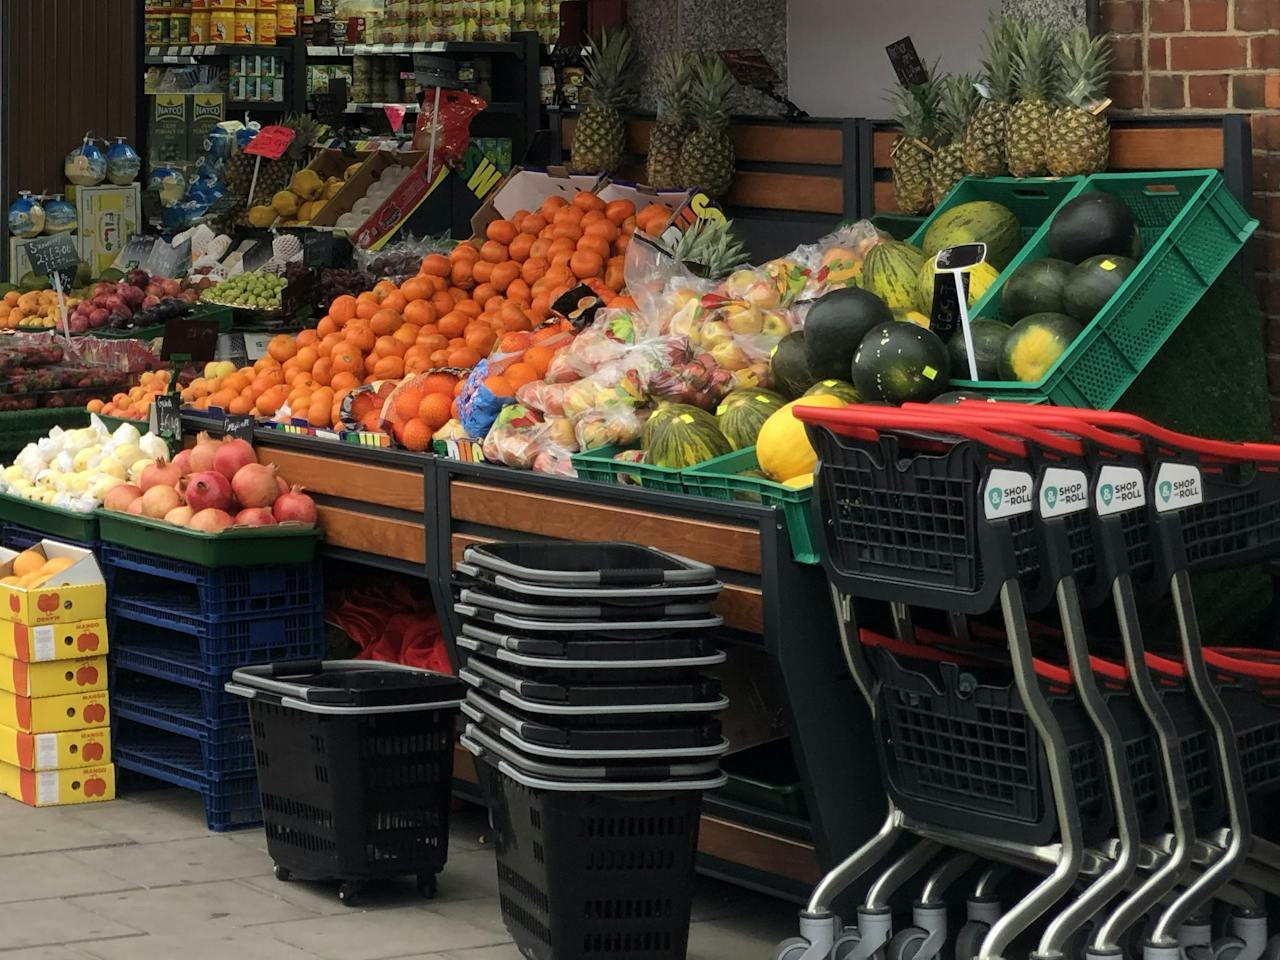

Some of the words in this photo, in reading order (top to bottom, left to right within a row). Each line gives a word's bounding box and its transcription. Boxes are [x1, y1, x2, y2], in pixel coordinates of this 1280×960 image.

[158, 106, 183, 115] NATCO
[196, 106, 220, 115] NATCO
[1059, 483, 1082, 496] SHOP
[1115, 481, 1138, 494] SHOP
[1173, 478, 1195, 491] SHOP
[1004, 485, 1027, 498] SHOP
[1121, 490, 1142, 501] ROLL
[1179, 487, 1199, 498] ROLL
[1010, 494, 1032, 506] ROLL
[1065, 492, 1086, 504] ROLL
[75, 622, 100, 630] MANGO
[82, 692, 106, 701] MANGO
[80, 731, 105, 740] MANGO
[83, 767, 107, 776] MANGO
